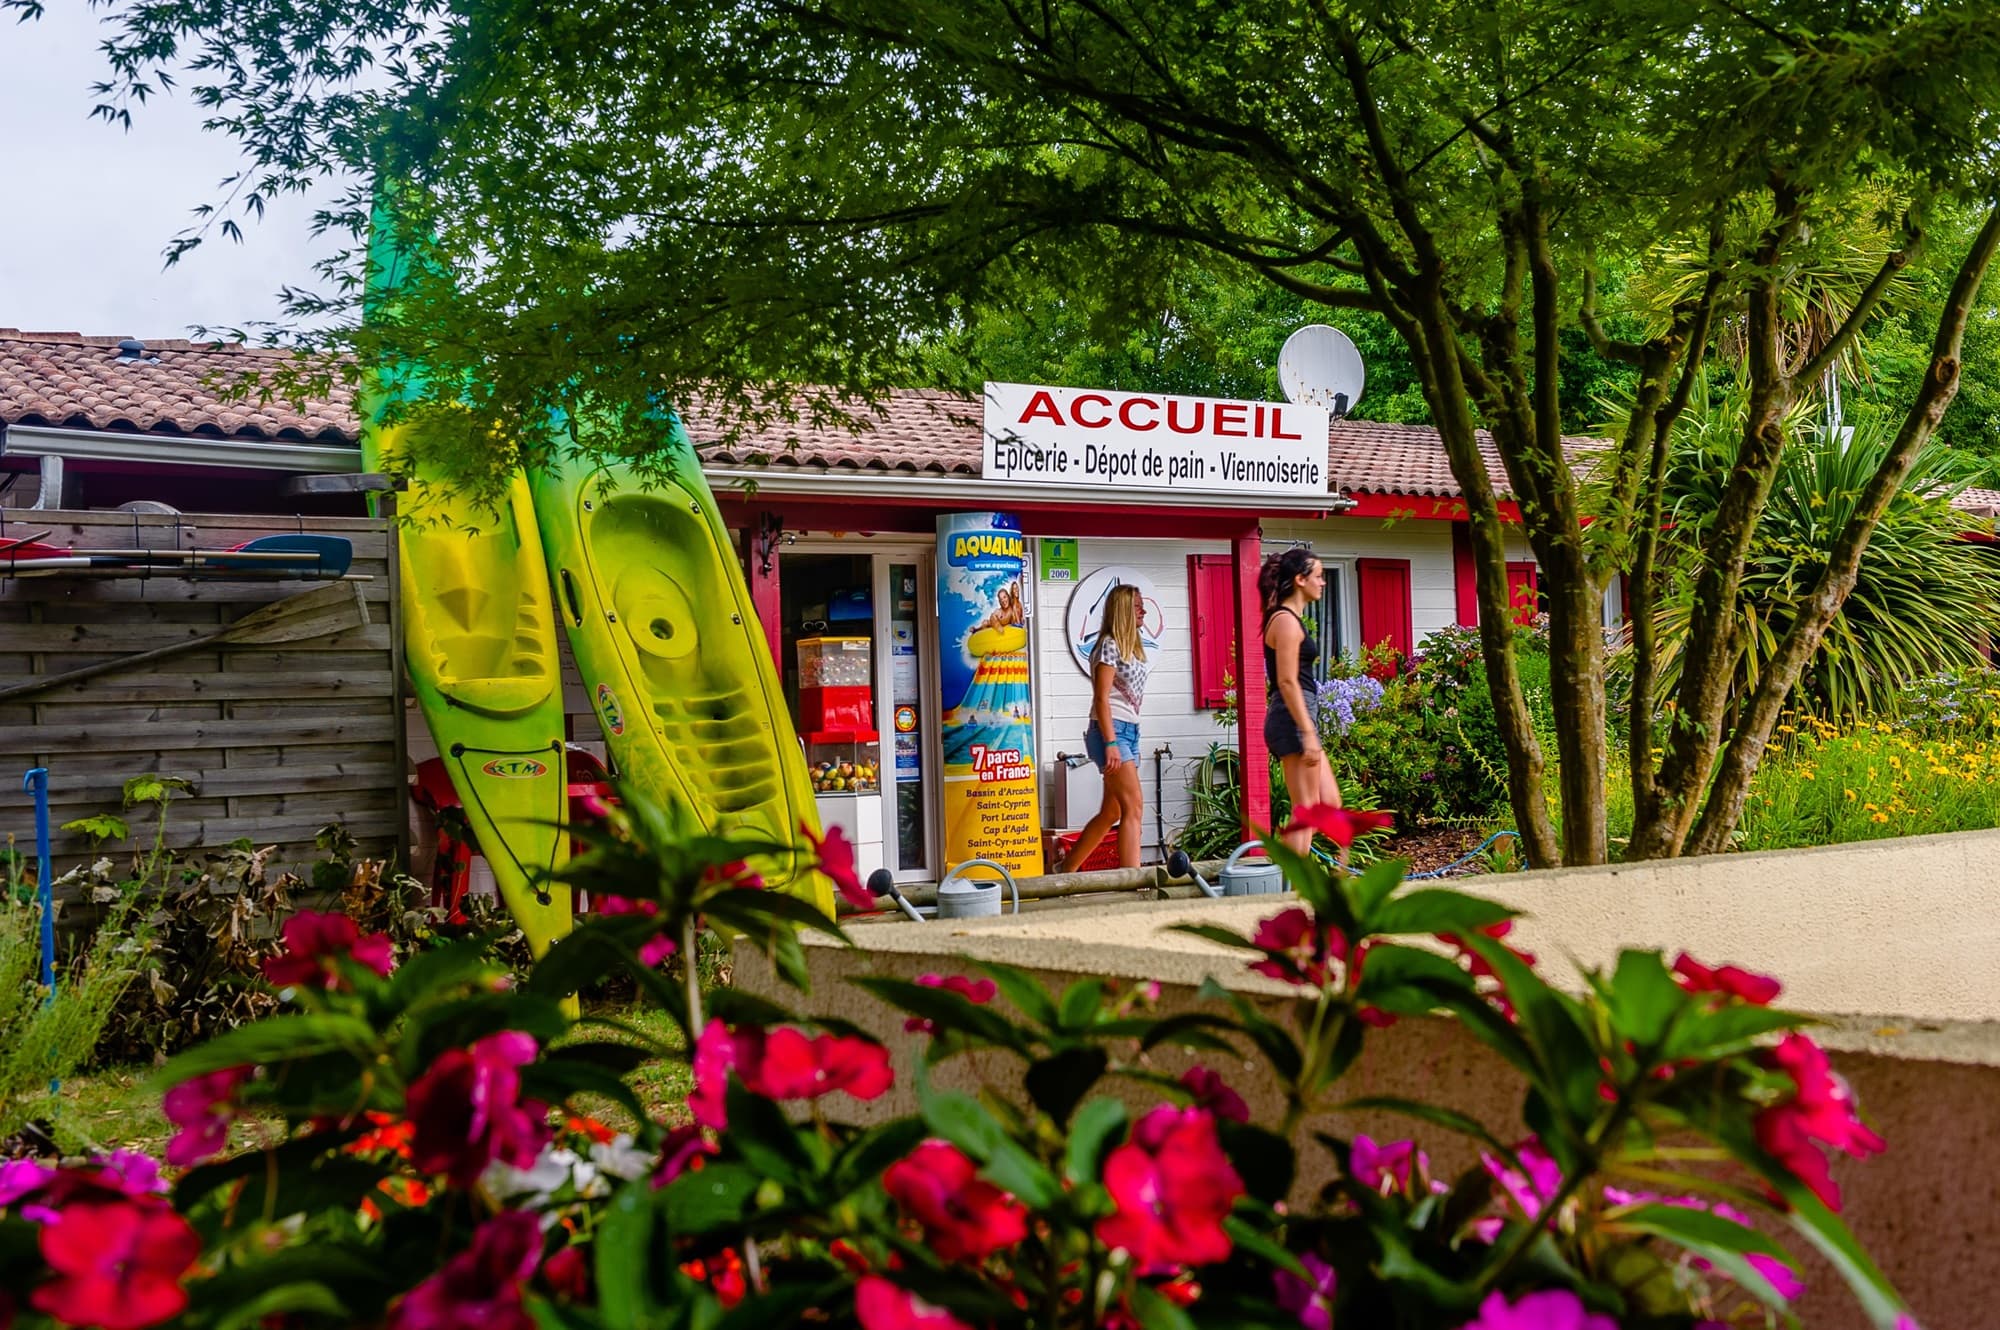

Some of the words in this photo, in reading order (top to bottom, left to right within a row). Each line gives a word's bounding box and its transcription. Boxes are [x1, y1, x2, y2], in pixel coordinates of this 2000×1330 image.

[1018, 390, 1303, 440] ACCUEIL
[994, 440, 1068, 478] Epicerie
[1085, 444, 1138, 482] Dépot
[1142, 448, 1163, 477] de
[1168, 450, 1205, 485] pain
[1220, 451, 1319, 484] Viennoiserie
[955, 535, 1022, 559] AQUALAN
[1050, 569, 1069, 578] 2009
[598, 691, 622, 728] RTM
[972, 747, 985, 771] 7
[987, 752, 1020, 768] parcs
[489, 762, 540, 774] RTM
[981, 770, 994, 781] en
[996, 765, 1030, 780] France
[966, 788, 996, 798] Bassin
[976, 799, 1031, 810] Saint-Cyprien
[981, 814, 999, 822] Port
[1001, 812, 1029, 821] Leucate
[983, 826, 1001, 836] Cap
[1002, 824, 1029, 835] d'Agde
[967, 836, 1039, 848] Saint-Cyr-sur-Mer
[975, 849, 1036, 860] Sainte-Maxime
